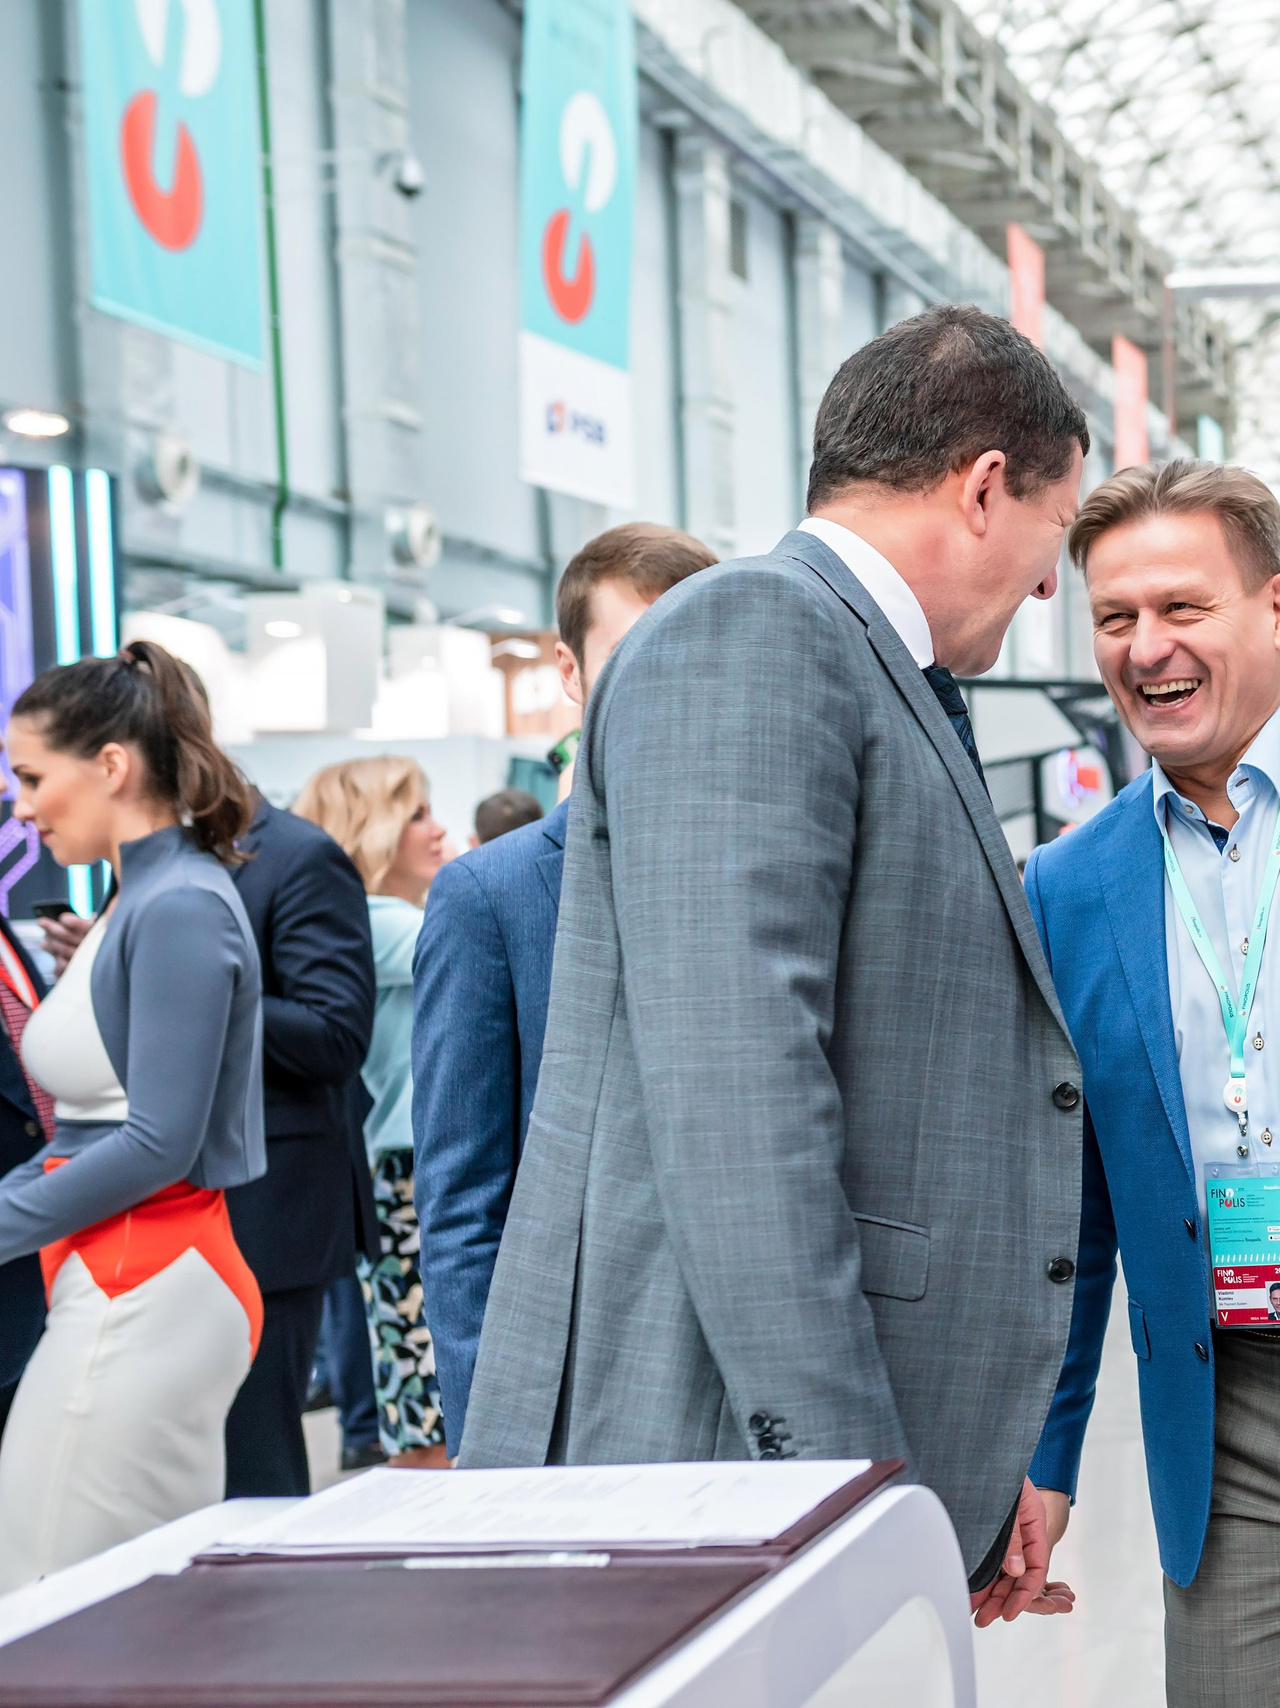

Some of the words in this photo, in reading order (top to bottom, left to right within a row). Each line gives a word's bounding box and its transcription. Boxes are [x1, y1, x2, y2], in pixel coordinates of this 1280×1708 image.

[1242, 983, 1250, 1009] FINOPOLIS
[1224, 991, 1235, 1018] FINOPOLIS
[1219, 1197, 1246, 1208] POLIS
[1223, 1275, 1243, 1284] POLIS
[1220, 1311, 1229, 1322] V
